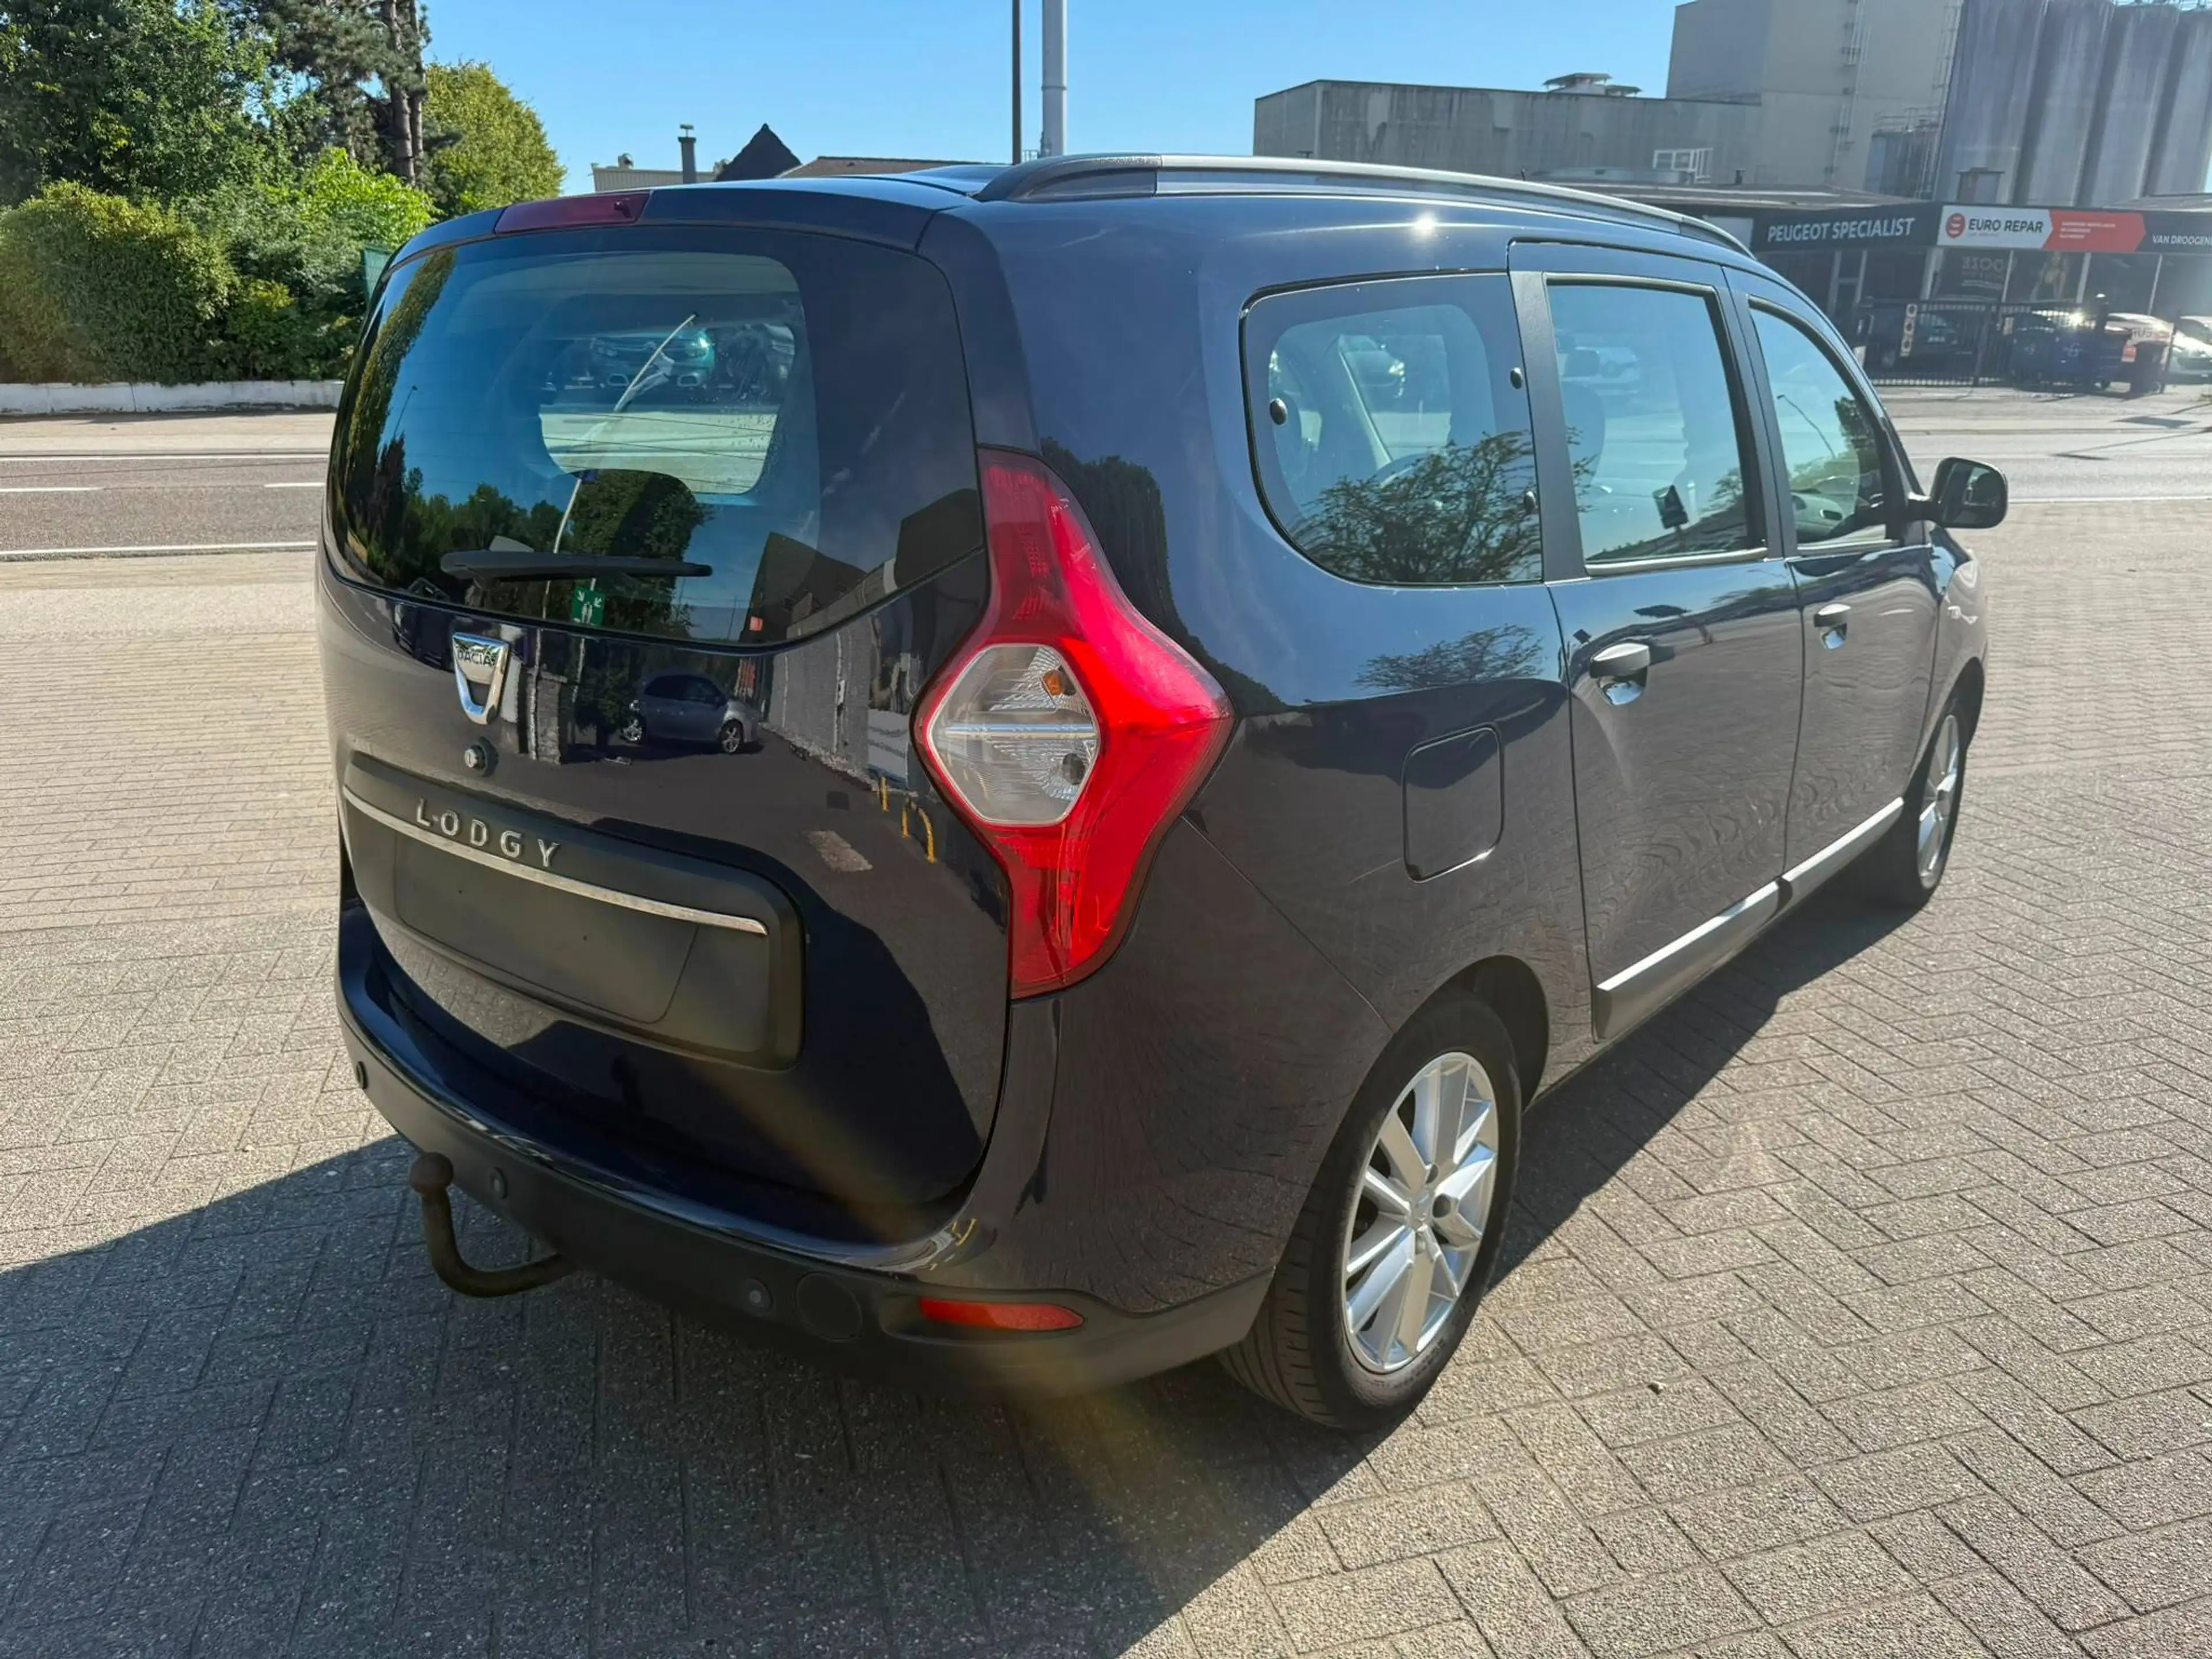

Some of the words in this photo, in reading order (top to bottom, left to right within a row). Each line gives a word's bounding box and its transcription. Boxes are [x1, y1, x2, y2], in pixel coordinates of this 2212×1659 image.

[1767, 223, 1831, 243] PEUGEOT
[1832, 218, 1915, 238] SPECIALIST
[1968, 218, 2001, 231] EURO
[2004, 220, 2044, 233] REPAR
[2152, 233, 2170, 244] VAN
[457, 647, 493, 666] DACIA
[416, 797, 561, 868] LODGY
